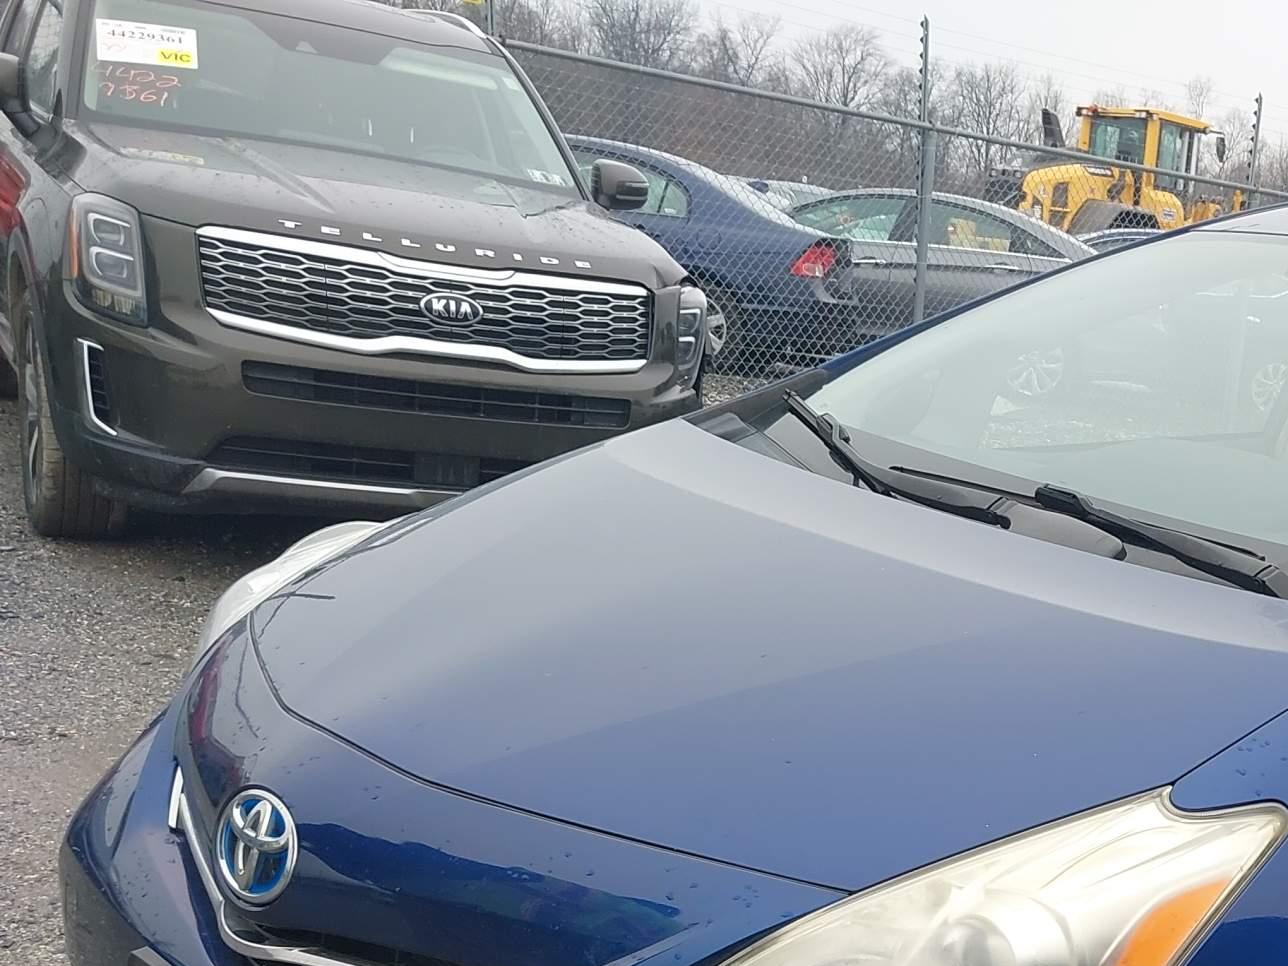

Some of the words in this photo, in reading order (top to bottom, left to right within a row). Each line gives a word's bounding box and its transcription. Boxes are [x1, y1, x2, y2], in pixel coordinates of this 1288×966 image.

[160, 51, 191, 63] VIC
[278, 219, 592, 269] TELLURIDE
[430, 297, 475, 322] KIA
